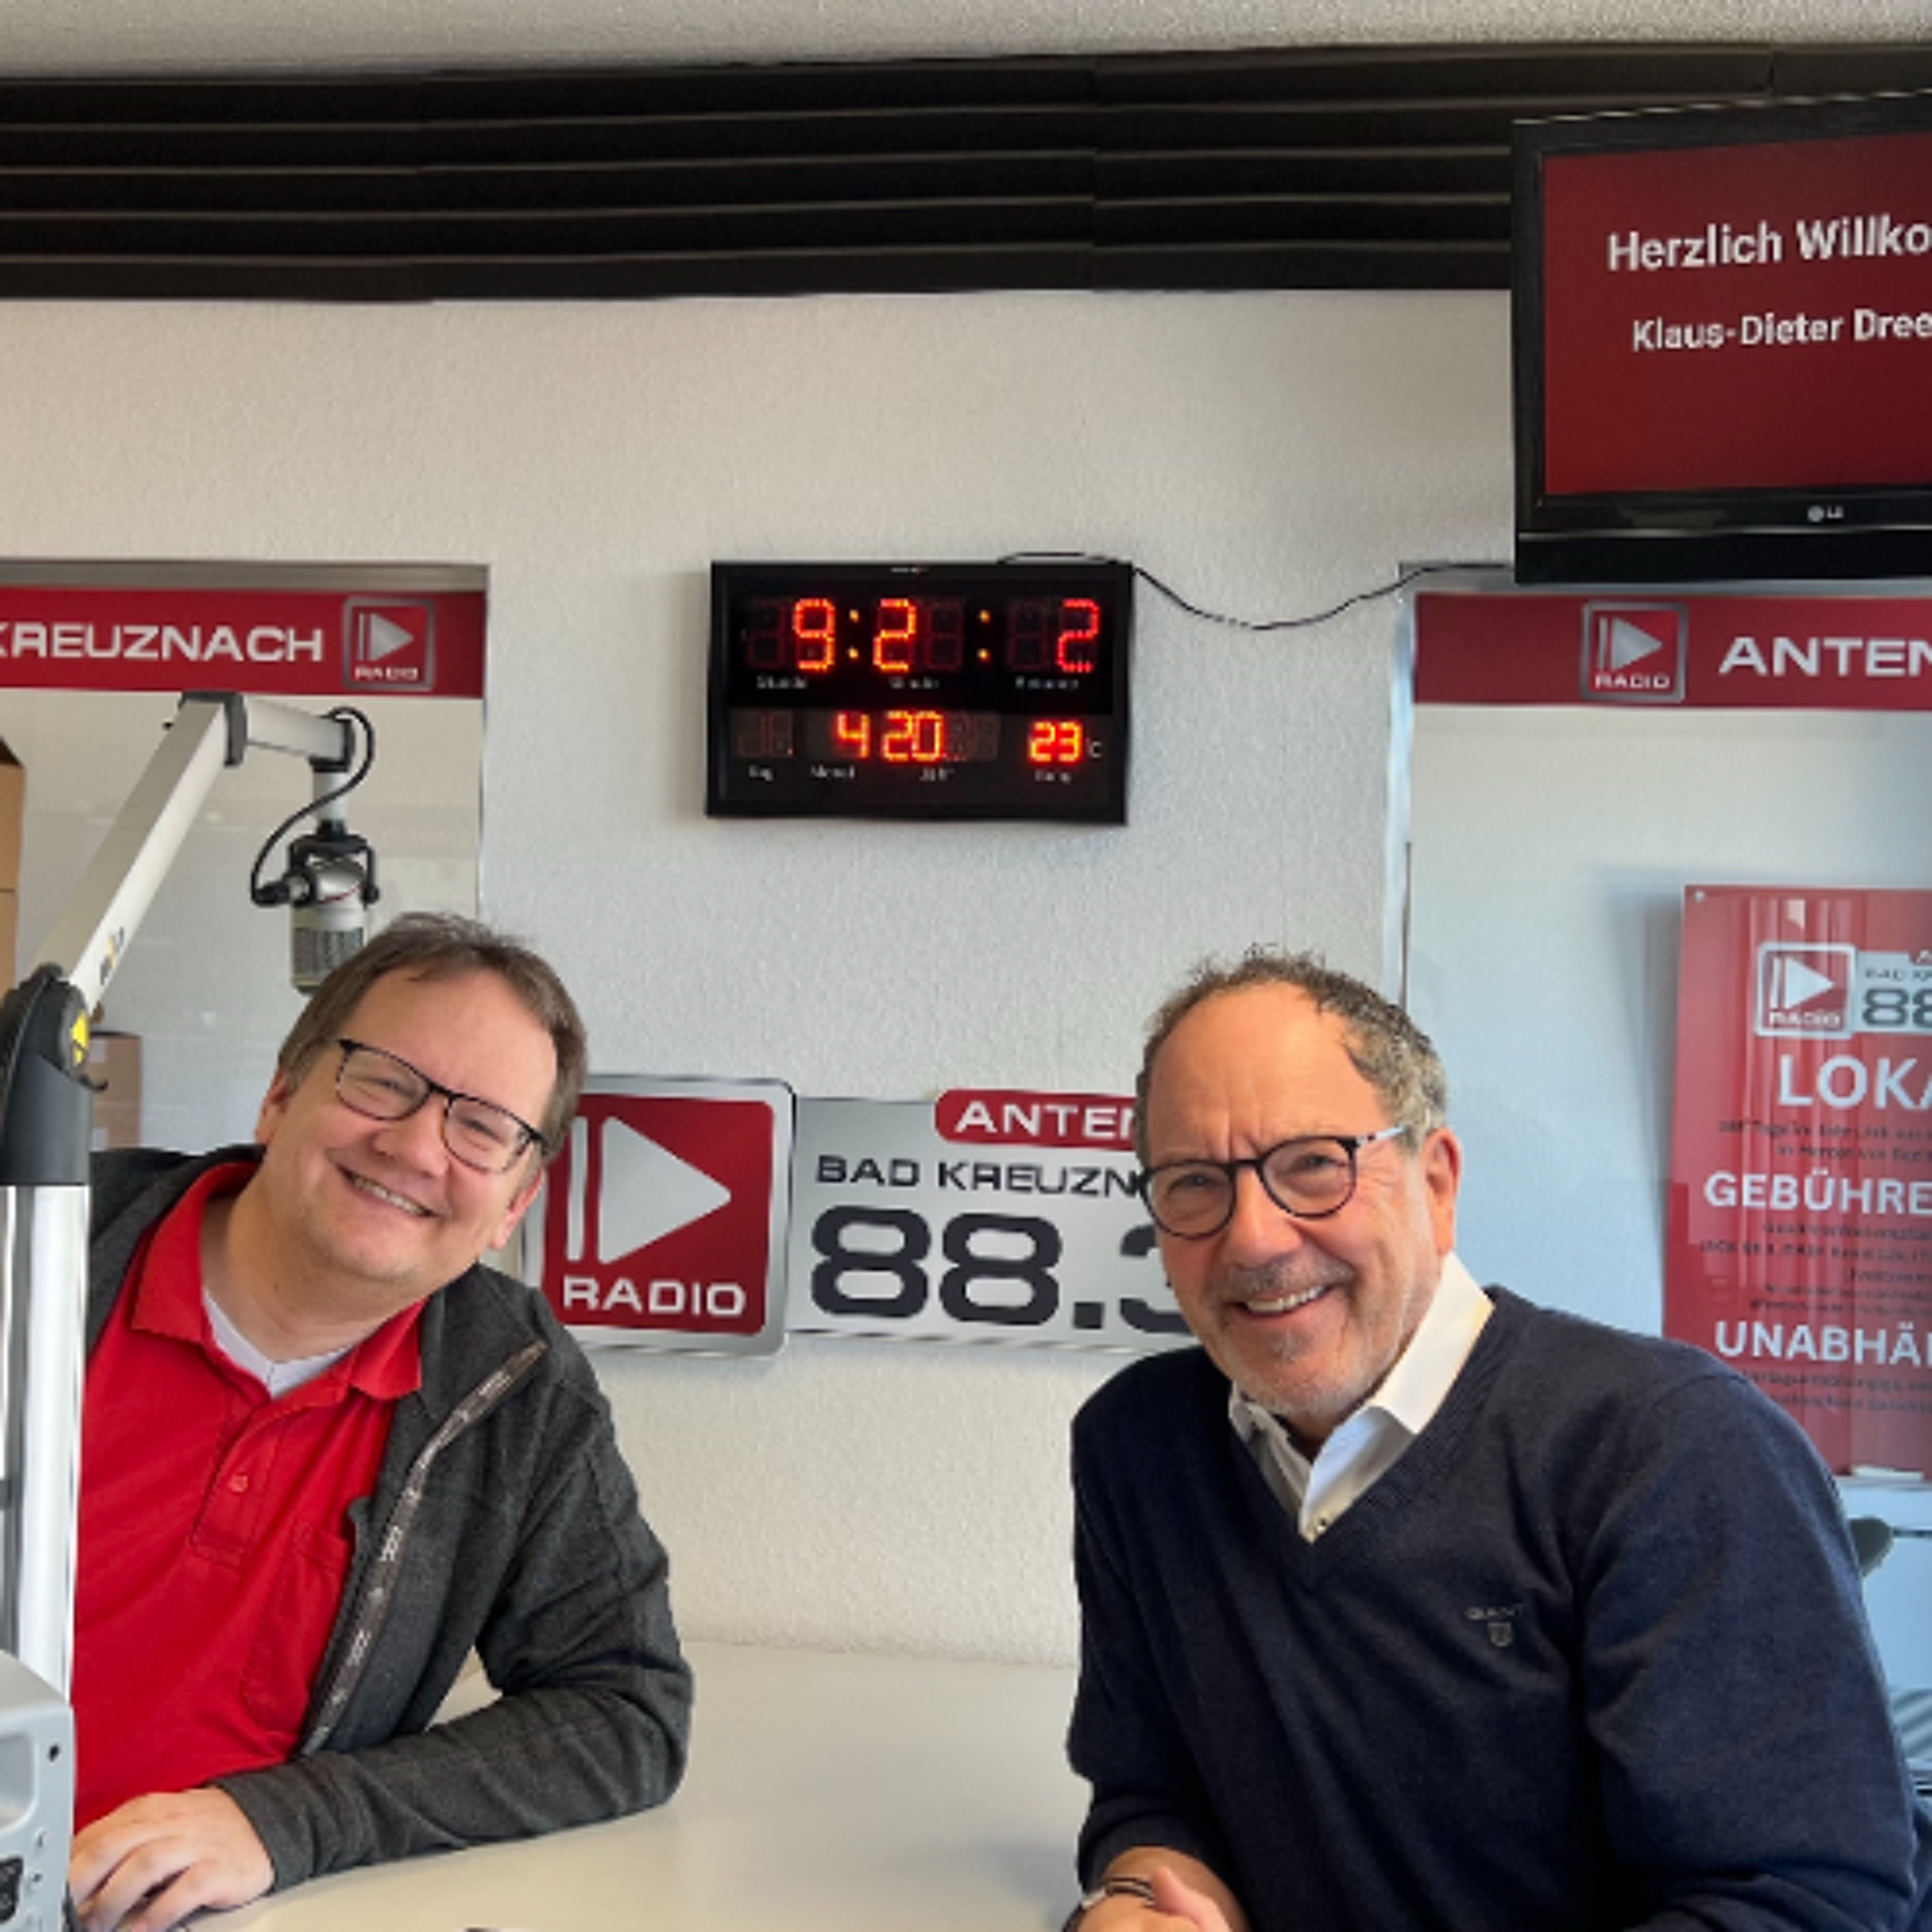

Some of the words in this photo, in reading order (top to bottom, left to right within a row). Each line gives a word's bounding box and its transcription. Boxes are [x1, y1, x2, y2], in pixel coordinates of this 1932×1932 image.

[1607, 221, 1783, 271] Herzlich
[1797, 213, 1932, 260] Willko
[1633, 313, 1843, 352] Klaus-Dieter
[1853, 308, 1932, 341] Dree
[0, 622, 323, 662] REUZNACH
[1595, 673, 1670, 689] RADIO
[1028, 719, 1083, 762] 23
[1778, 1053, 1932, 1110] LOK
[816, 1155, 920, 1187] BAD
[1704, 1167, 1932, 1215] GEBÜHRE
[562, 1274, 746, 1317] RADIO
[1715, 1321, 1932, 1367] UNABHÄ
